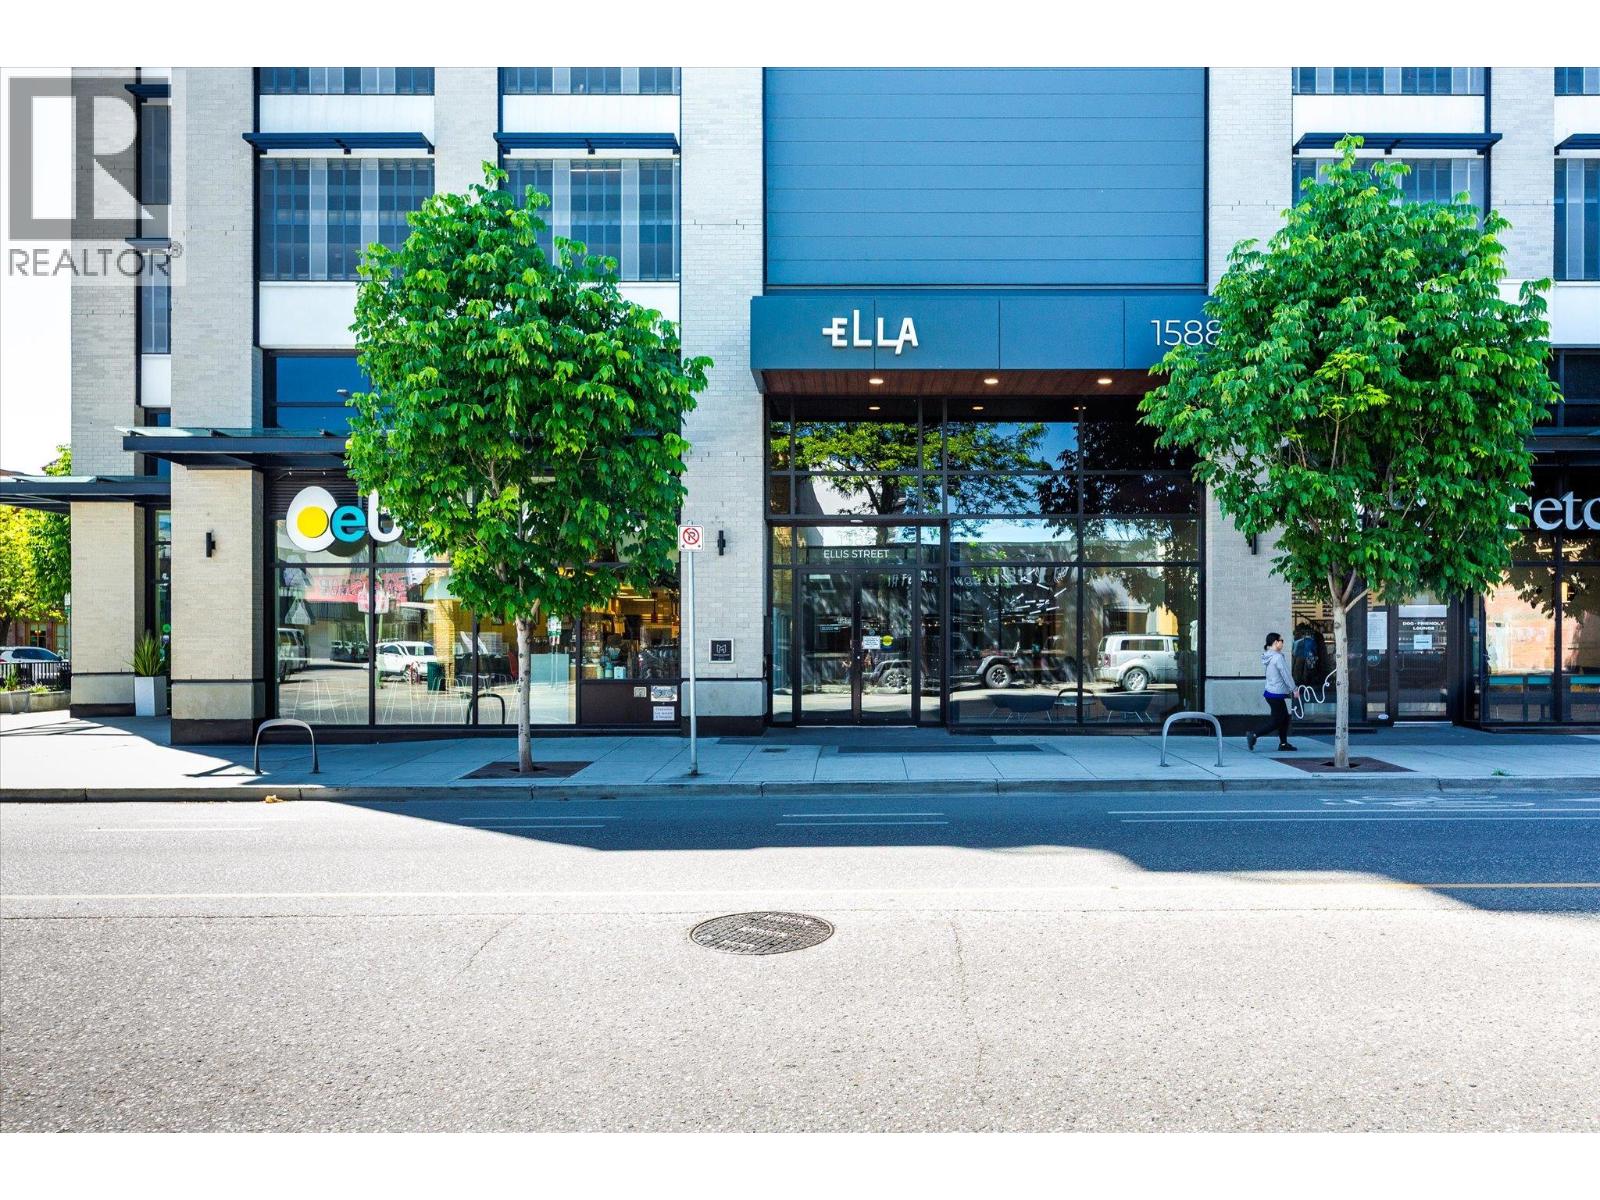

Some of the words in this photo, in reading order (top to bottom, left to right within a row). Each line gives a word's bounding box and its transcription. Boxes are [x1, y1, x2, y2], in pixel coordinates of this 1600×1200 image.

[822, 309, 919, 355] ELLA
[1151, 319, 1223, 346] 1588
[823, 549, 849, 559] ELLIS
[851, 549, 889, 559] STREET
